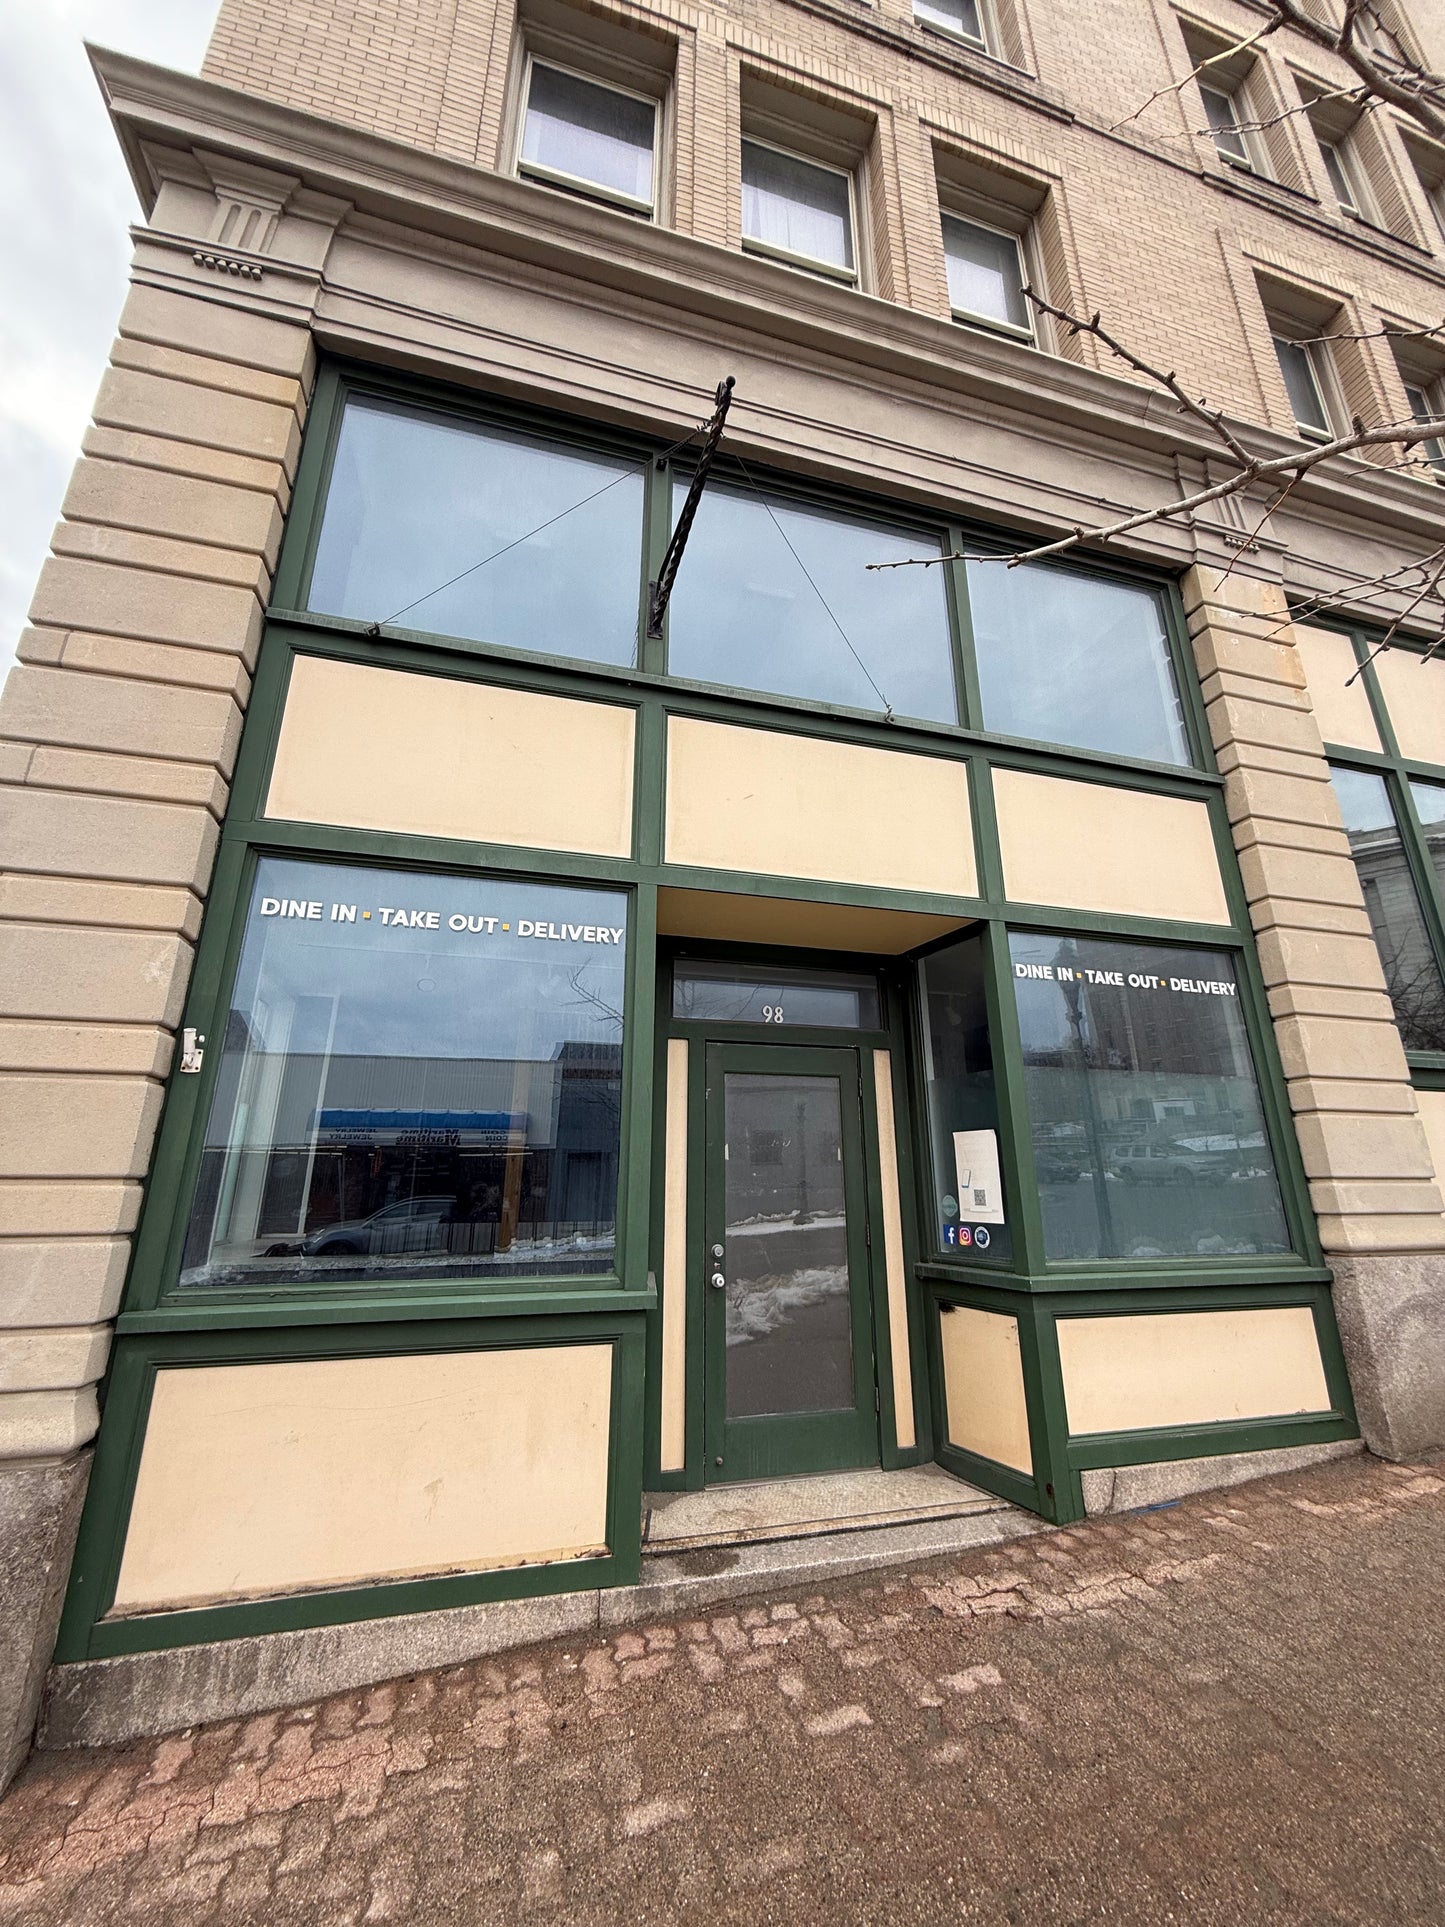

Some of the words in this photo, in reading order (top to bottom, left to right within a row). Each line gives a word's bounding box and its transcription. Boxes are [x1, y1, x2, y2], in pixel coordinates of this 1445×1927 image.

[260, 898, 323, 919] DINE
[331, 904, 357, 922] IN
[379, 908, 440, 930] TAKE
[449, 914, 499, 934] OUT
[518, 920, 624, 945] DELIVERY
[1015, 963, 1053, 980] DINE
[1057, 967, 1073, 981] IN
[1085, 970, 1125, 986] TAKE
[1128, 974, 1159, 989] OUT
[1170, 978, 1235, 996] DELIVERY
[762, 1005, 784, 1024] 98
